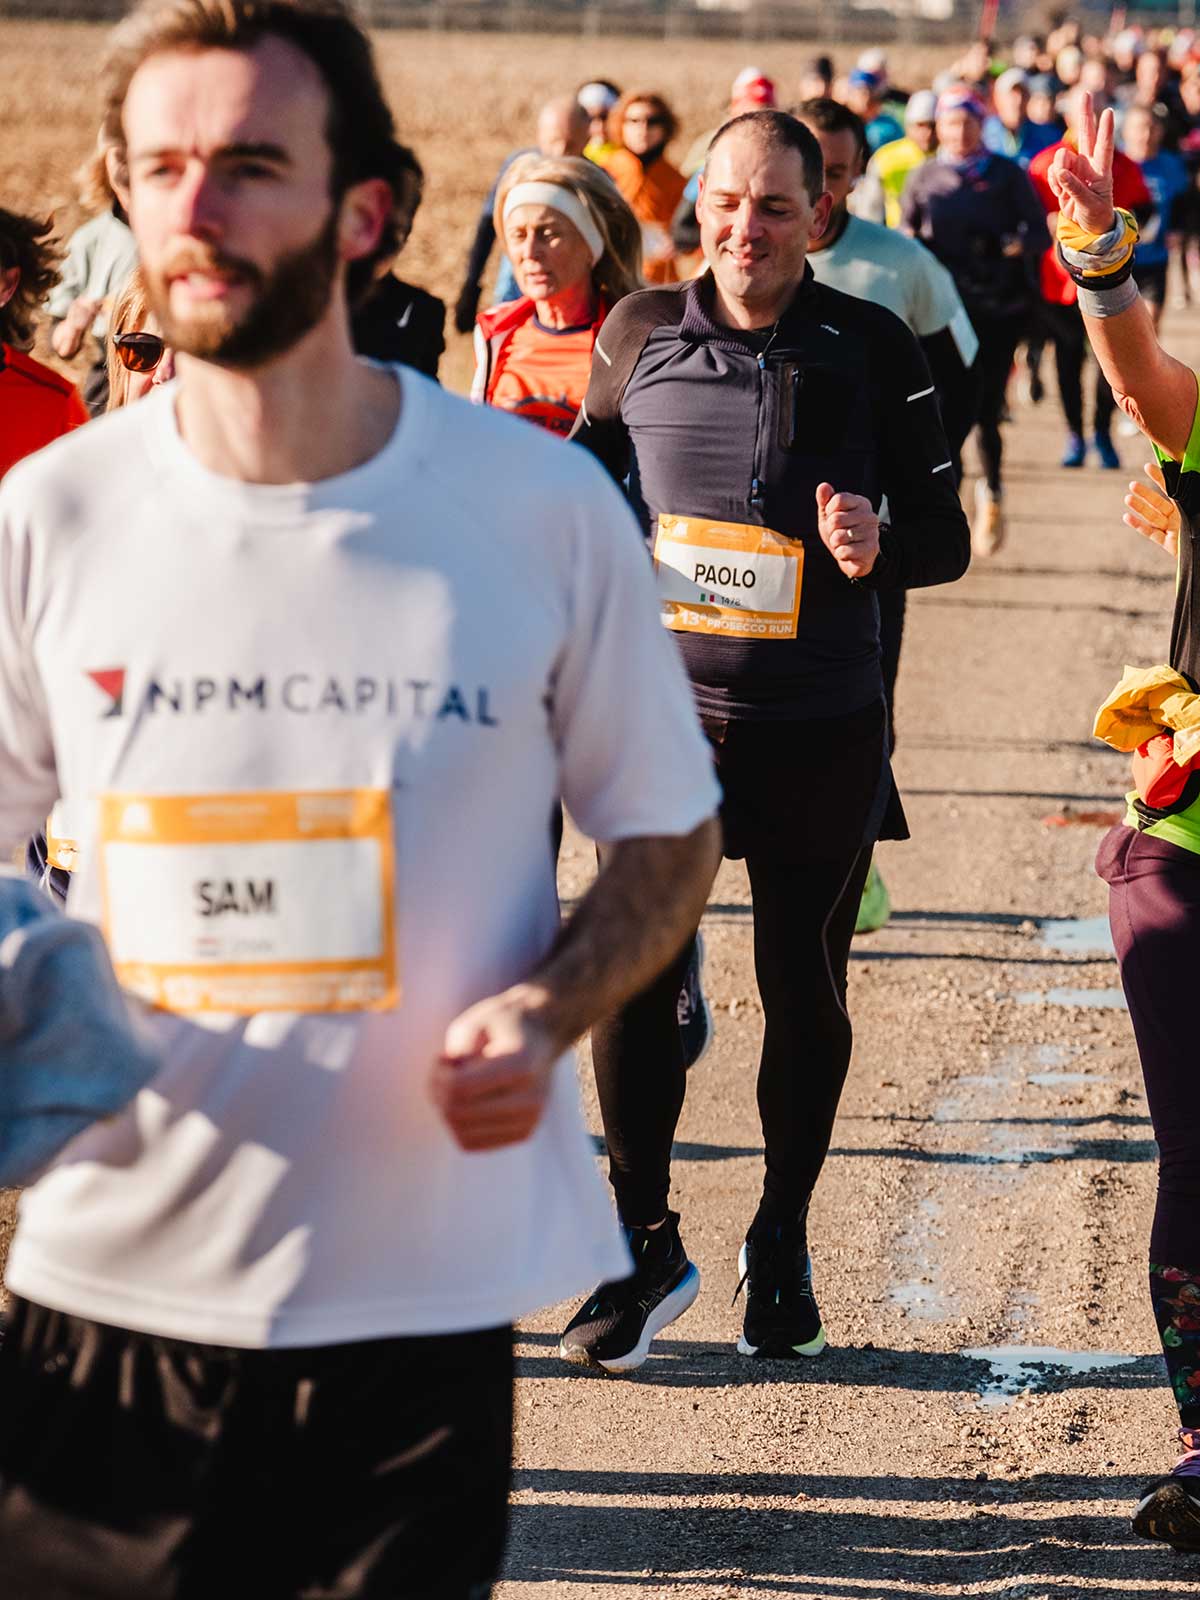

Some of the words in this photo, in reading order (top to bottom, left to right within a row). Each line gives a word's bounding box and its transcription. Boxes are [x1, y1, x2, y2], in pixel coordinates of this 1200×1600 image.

[694, 564, 756, 588] PAOLO
[707, 618, 767, 633] PROSECCO
[769, 623, 793, 634] RUN
[144, 674, 267, 716] NPM
[281, 673, 500, 726] CAPITAL
[196, 879, 276, 917] SAM
